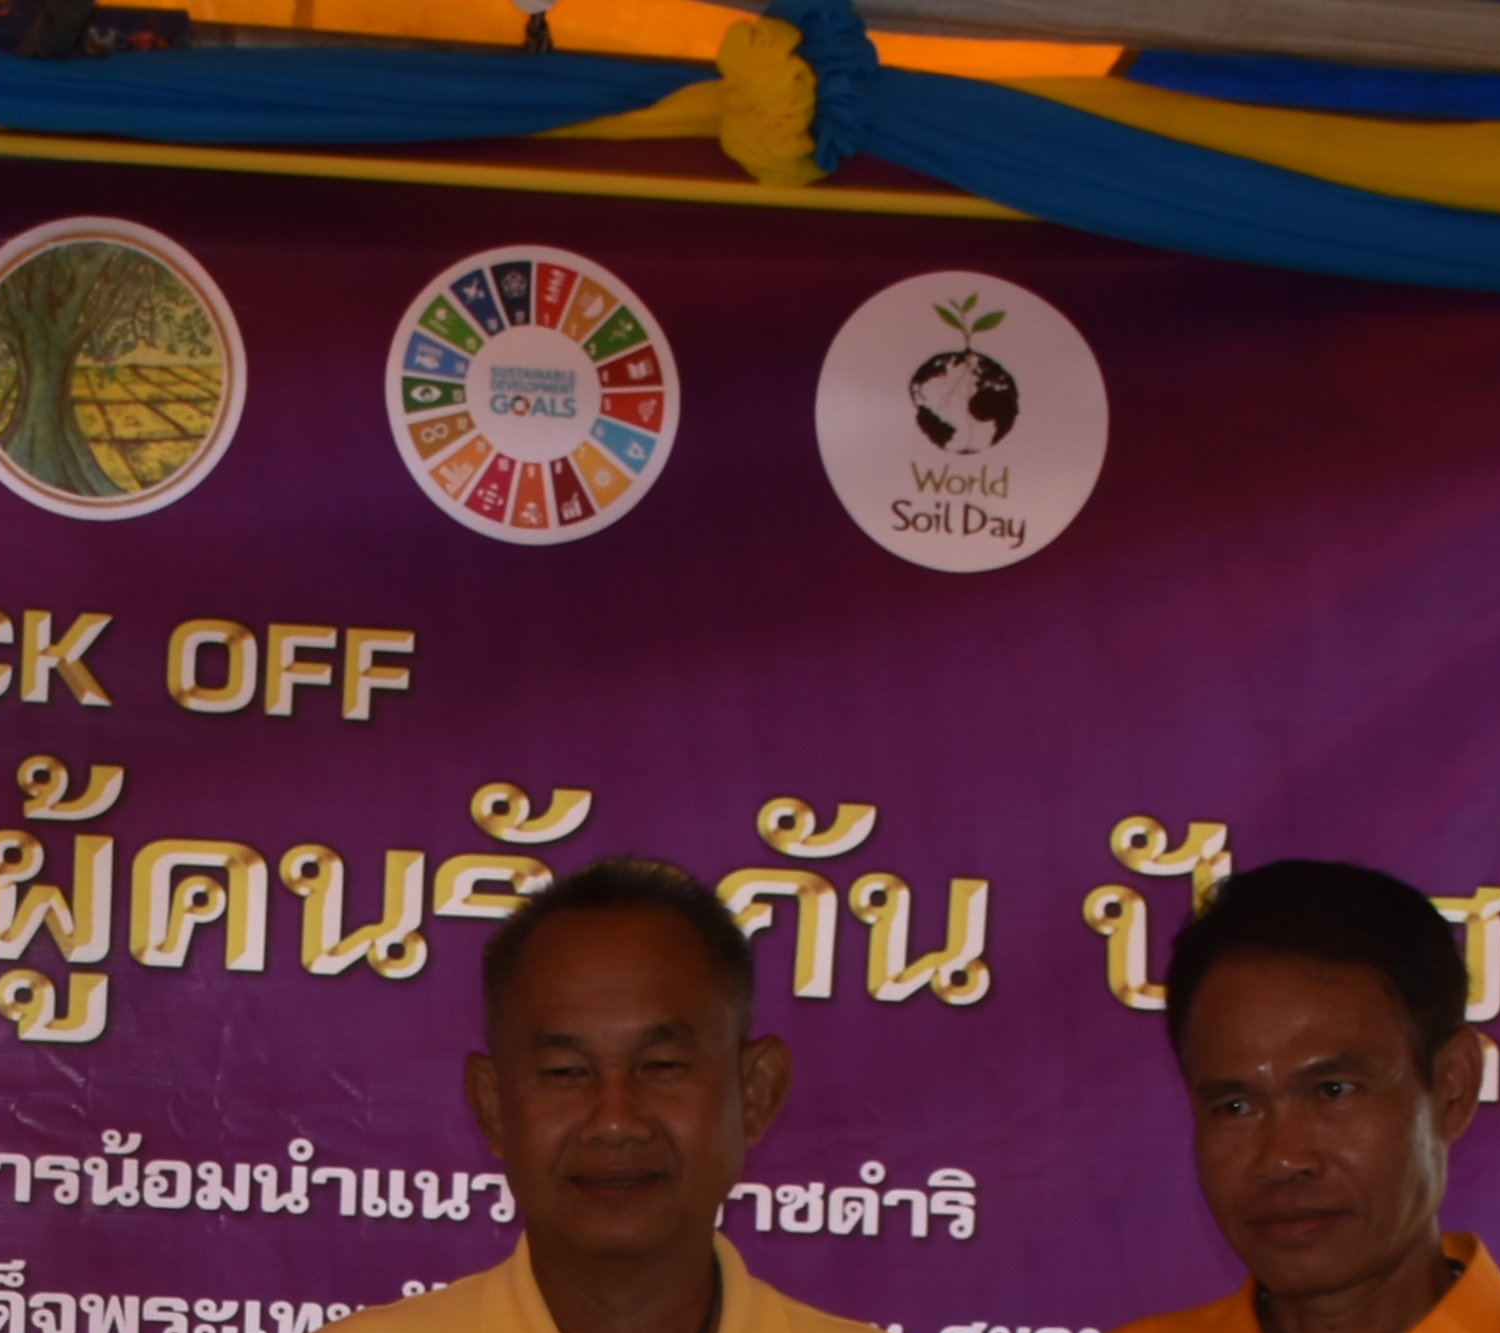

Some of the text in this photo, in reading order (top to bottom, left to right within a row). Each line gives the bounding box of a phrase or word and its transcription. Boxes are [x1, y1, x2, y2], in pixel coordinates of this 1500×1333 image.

[490, 366, 576, 382] SUSTAINABLE
[490, 379, 575, 395] DEVELOPMENT
[490, 394, 577, 418] GOALS
[911, 462, 1009, 499] World
[891, 499, 1026, 550] Soil Day
[166, 618, 416, 721] OFF
